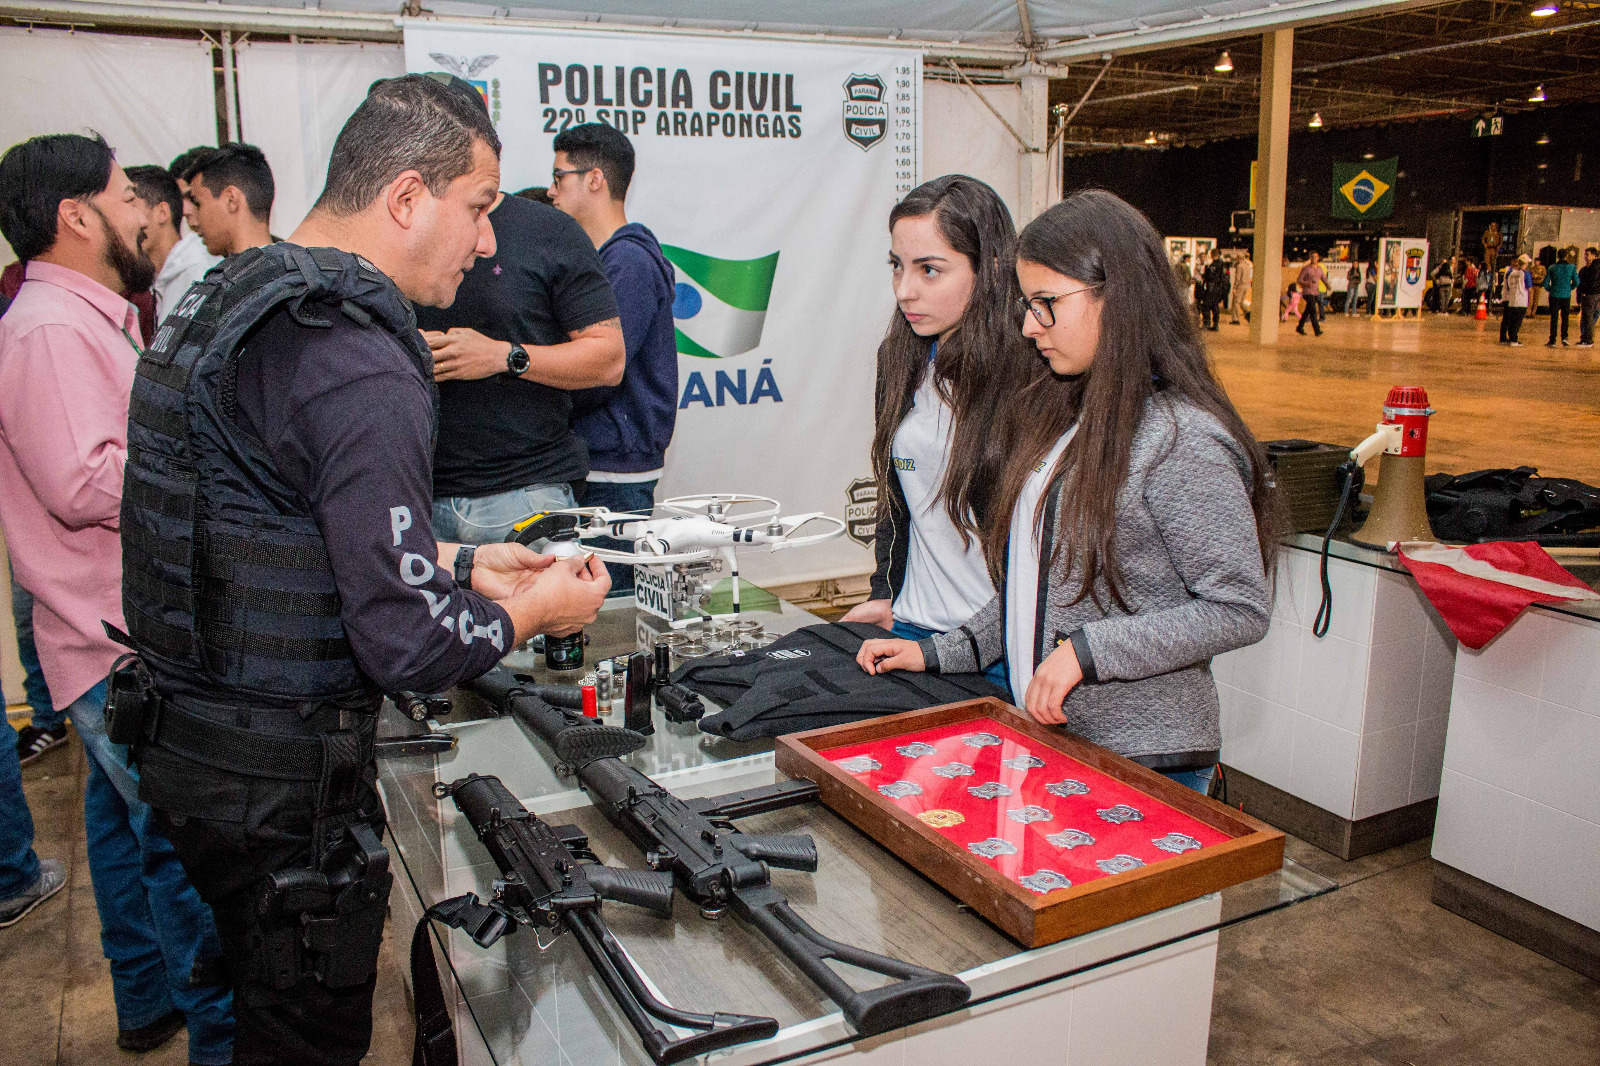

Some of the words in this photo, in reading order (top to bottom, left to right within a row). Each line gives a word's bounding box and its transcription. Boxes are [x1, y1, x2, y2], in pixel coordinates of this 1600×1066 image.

[538, 62, 693, 108] POLICIA
[709, 70, 802, 113] CIVIL
[854, 87, 877, 96] PARANÁ
[846, 102, 885, 116] POLÍCIA
[596, 109, 647, 135] SDP
[656, 111, 802, 139] ARAPONGAS
[854, 126, 877, 137] CIVIL
[678, 358, 784, 410] ANÁ
[855, 490, 877, 498] PARAN
[637, 583, 668, 615] CIVIL
